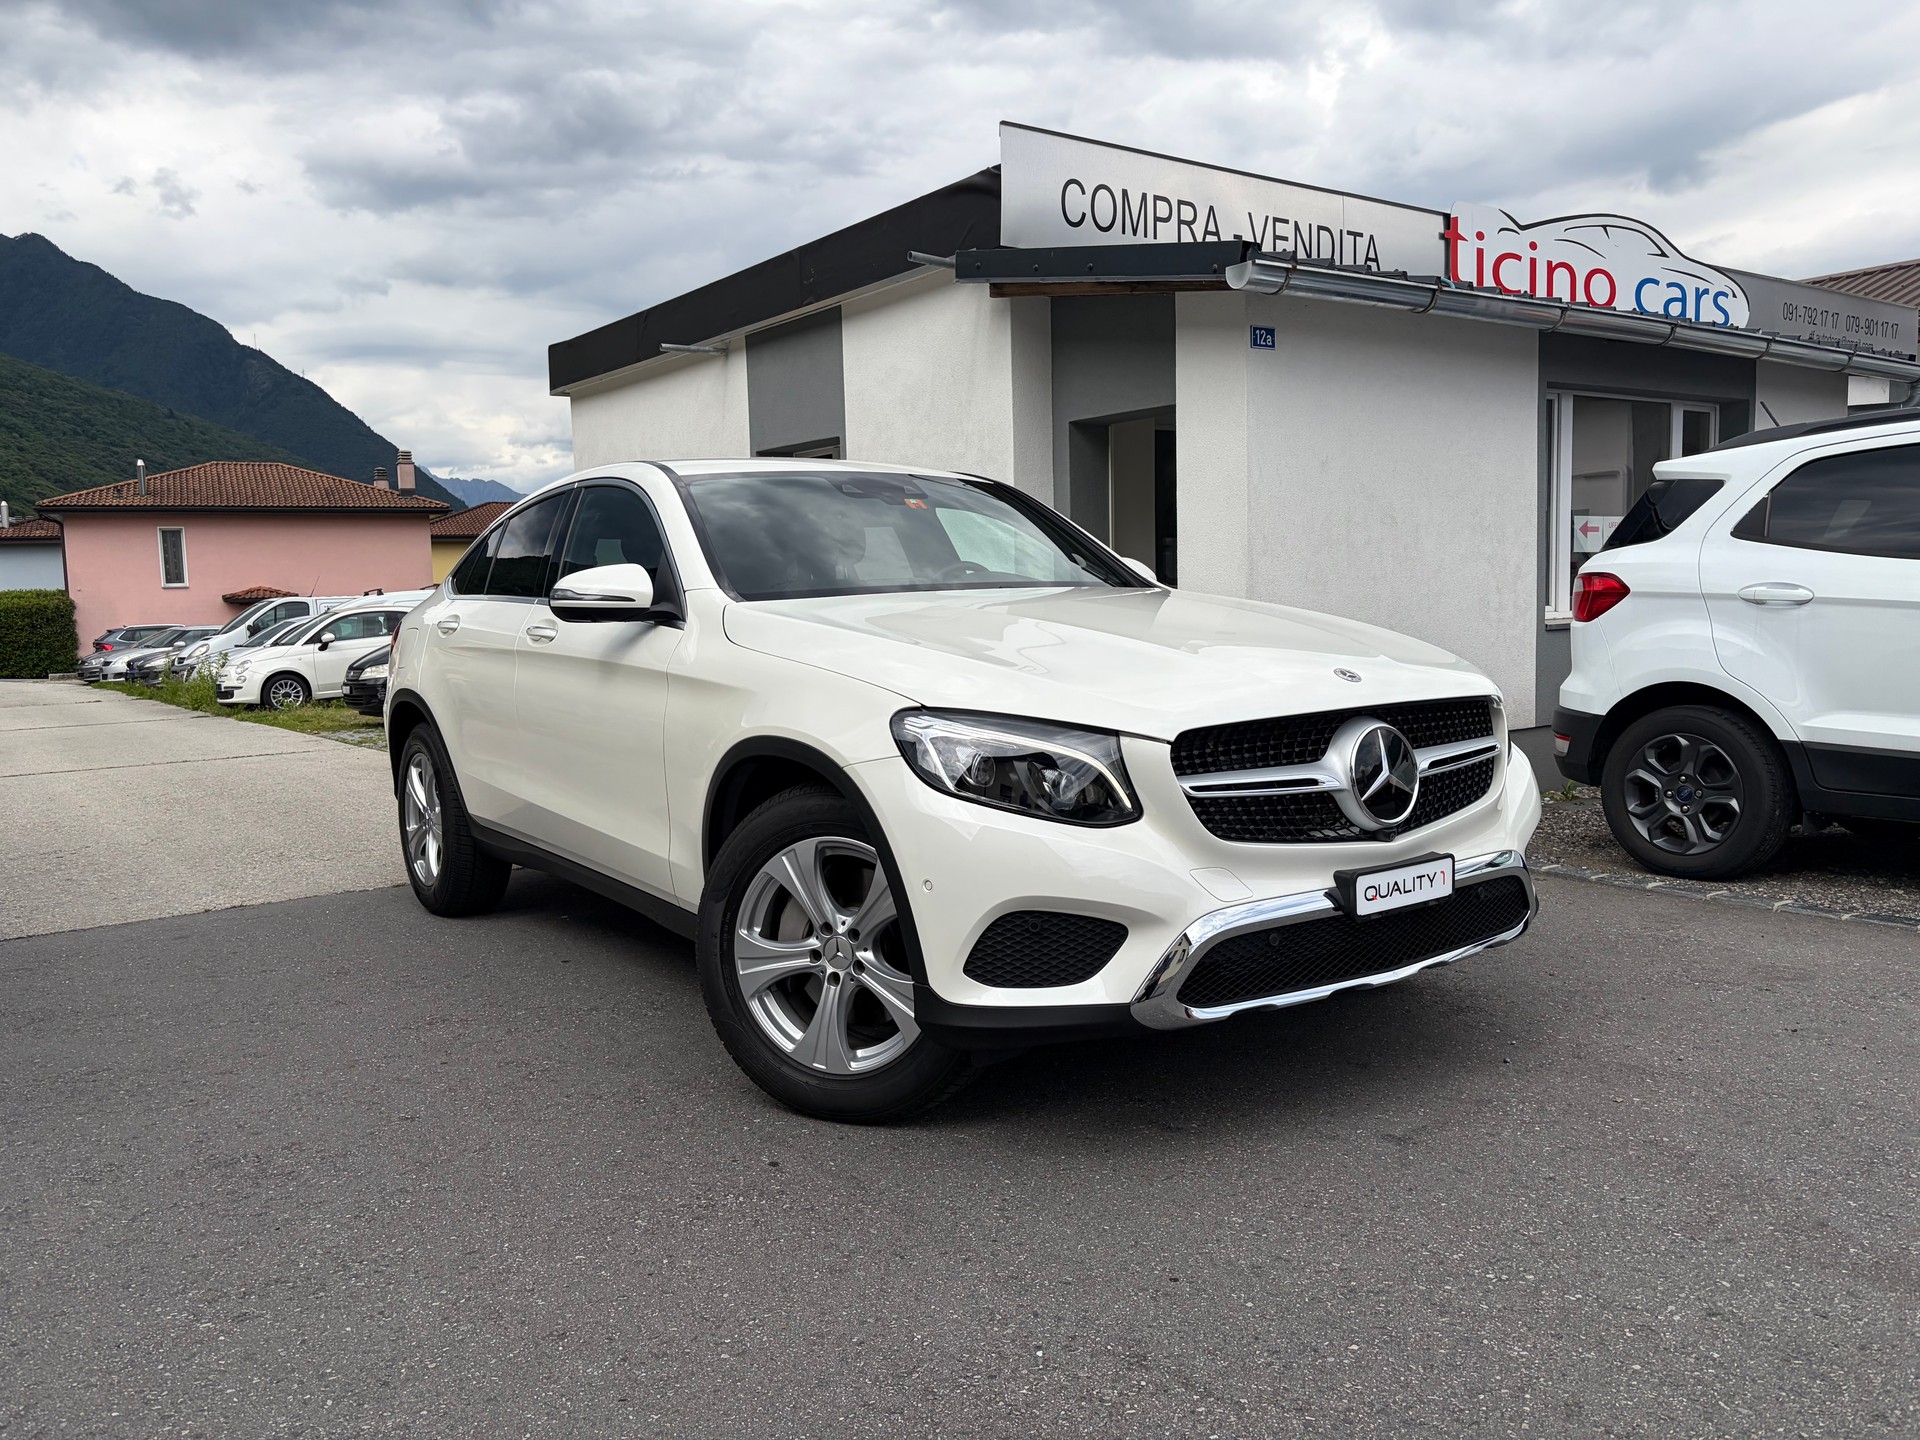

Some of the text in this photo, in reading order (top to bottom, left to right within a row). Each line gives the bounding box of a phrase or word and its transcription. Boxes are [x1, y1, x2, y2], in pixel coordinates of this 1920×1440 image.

[1061, 178, 1222, 243] COMPRA
[1247, 211, 1381, 272] VENDITA
[1444, 216, 1730, 327] ticino cars
[1255, 329, 1273, 346] 12a
[1782, 302, 1899, 340] 091-792 17 17 079-901 17 17
[1364, 870, 1446, 902] QUALITY 1
